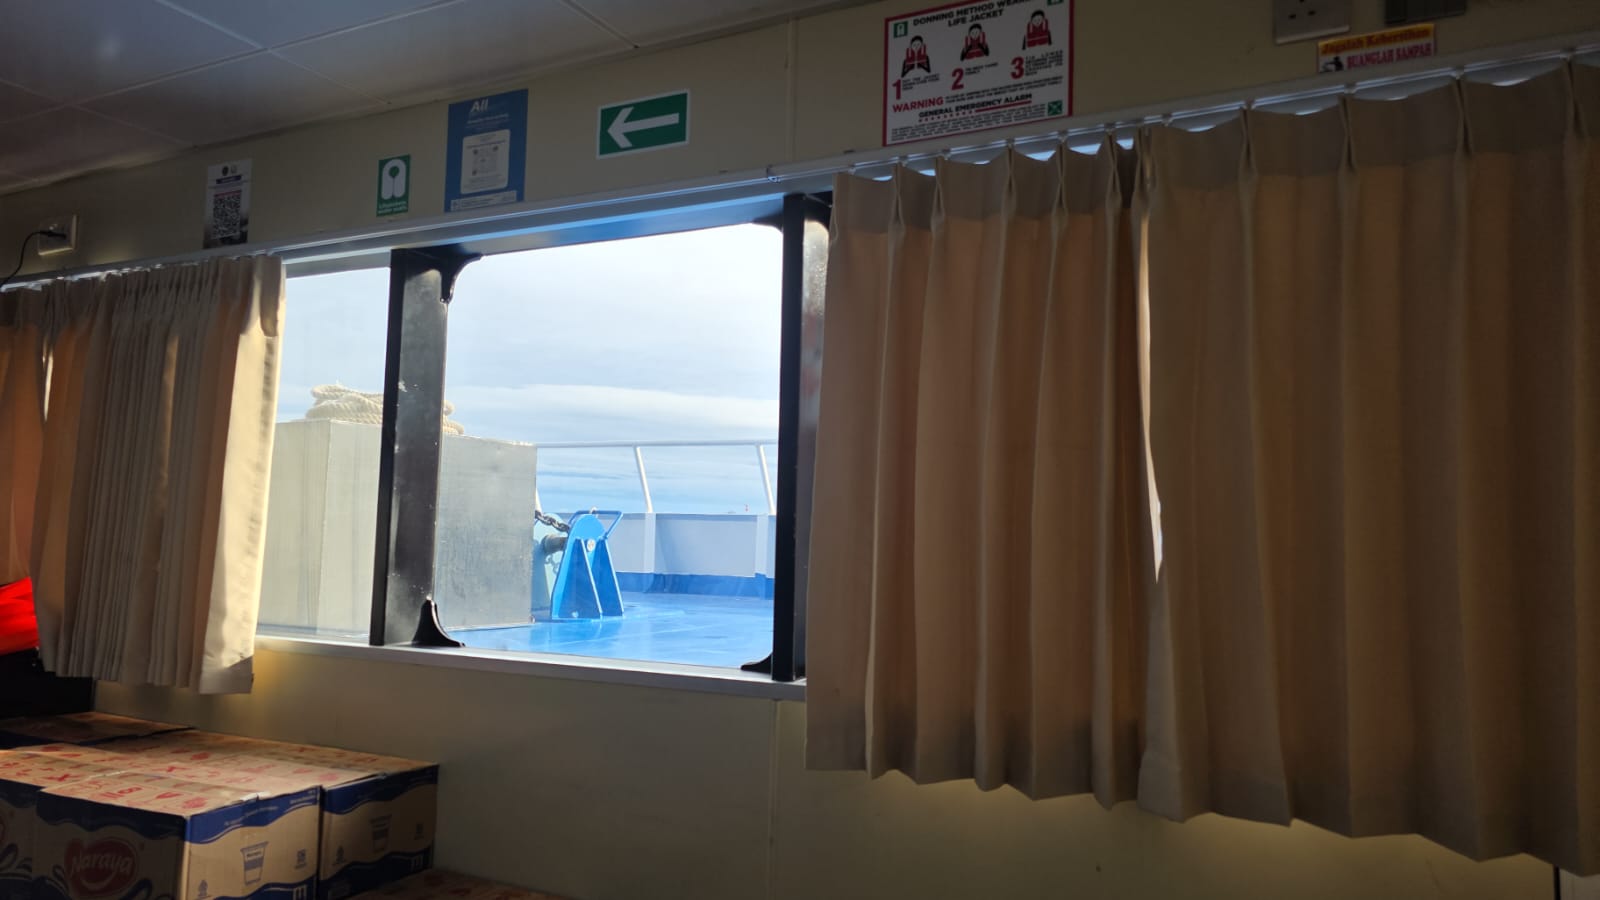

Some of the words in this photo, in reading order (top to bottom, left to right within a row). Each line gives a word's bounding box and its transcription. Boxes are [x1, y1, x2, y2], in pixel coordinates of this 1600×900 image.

[913, 11, 954, 26] DONNING
[956, 3, 994, 18] METHOD
[948, 17, 967, 28] LIFE
[969, 9, 1004, 23] JACKET
[951, 68, 964, 91] 2
[1010, 56, 1024, 80] 3
[892, 79, 902, 100] 1
[892, 96, 944, 113] WARNING
[918, 107, 953, 118] GENERAL
[955, 98, 1002, 113] EMERGENCY
[1004, 93, 1032, 104] ALARM
[71, 848, 134, 877] Naraya
